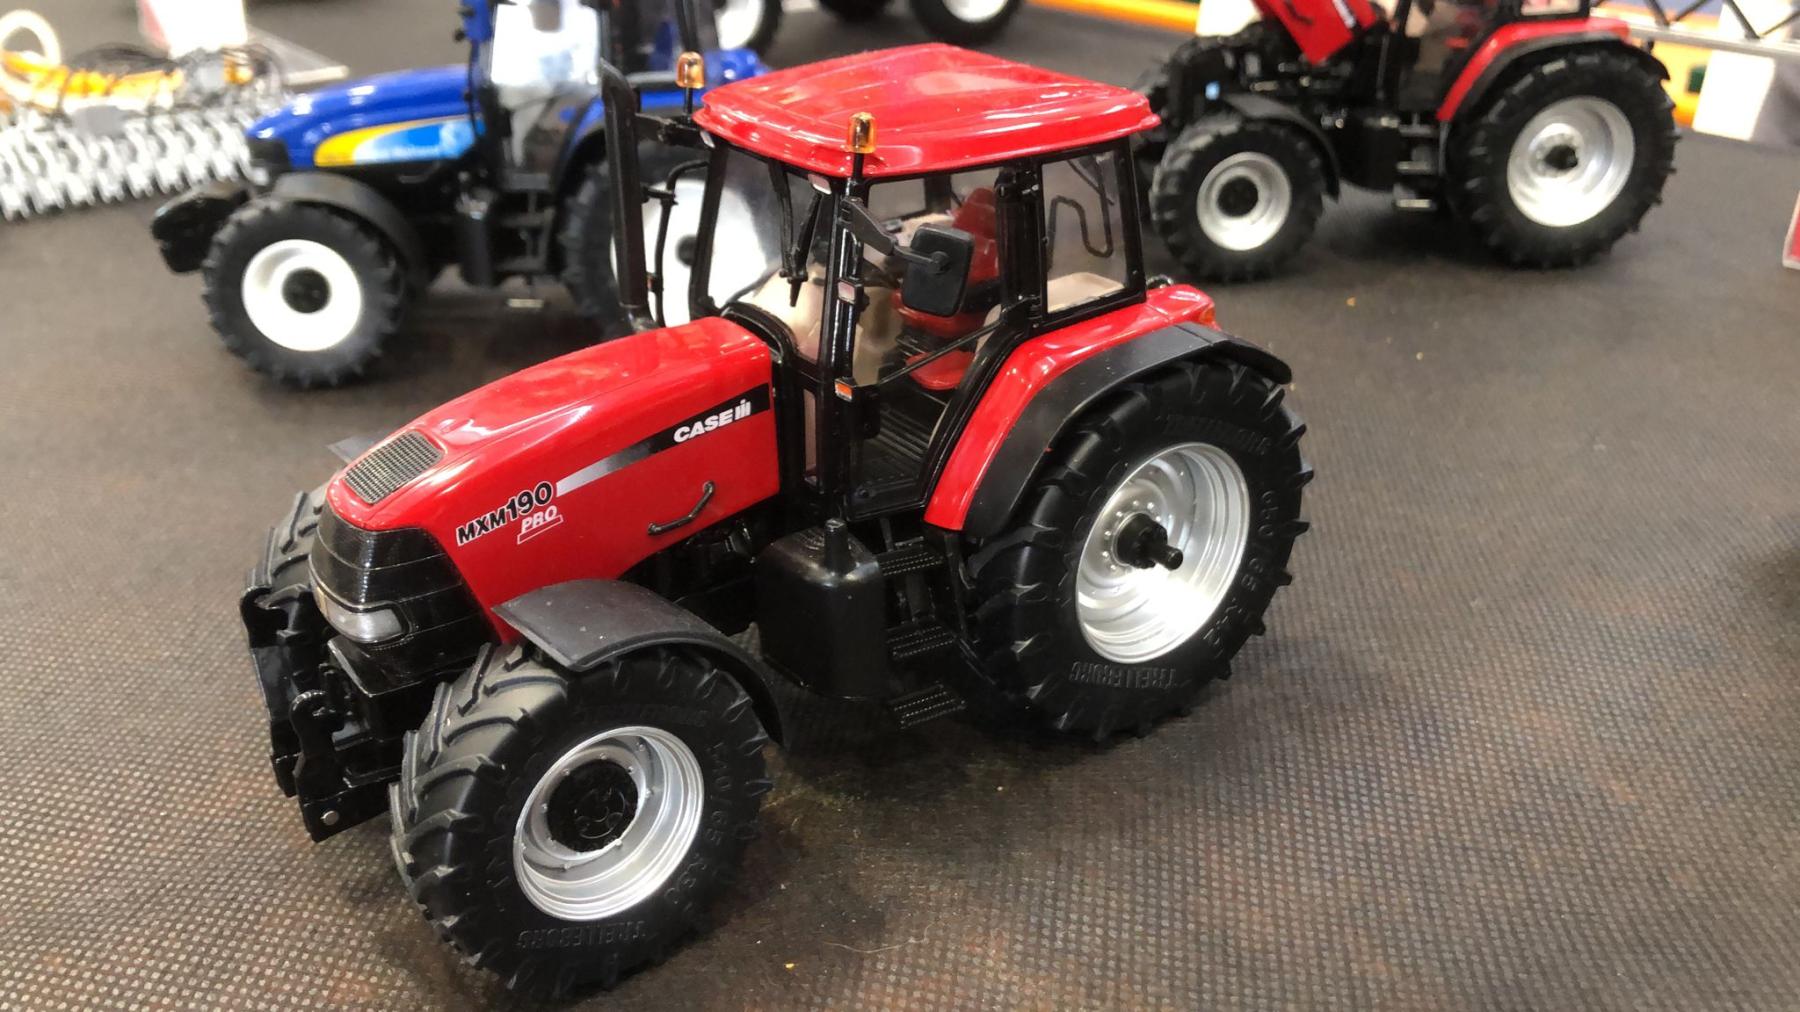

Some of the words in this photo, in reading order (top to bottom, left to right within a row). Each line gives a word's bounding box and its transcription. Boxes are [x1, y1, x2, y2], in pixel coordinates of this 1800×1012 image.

[673, 408, 734, 443] CASE
[455, 480, 555, 547] MXM190
[520, 505, 558, 533] PRO
